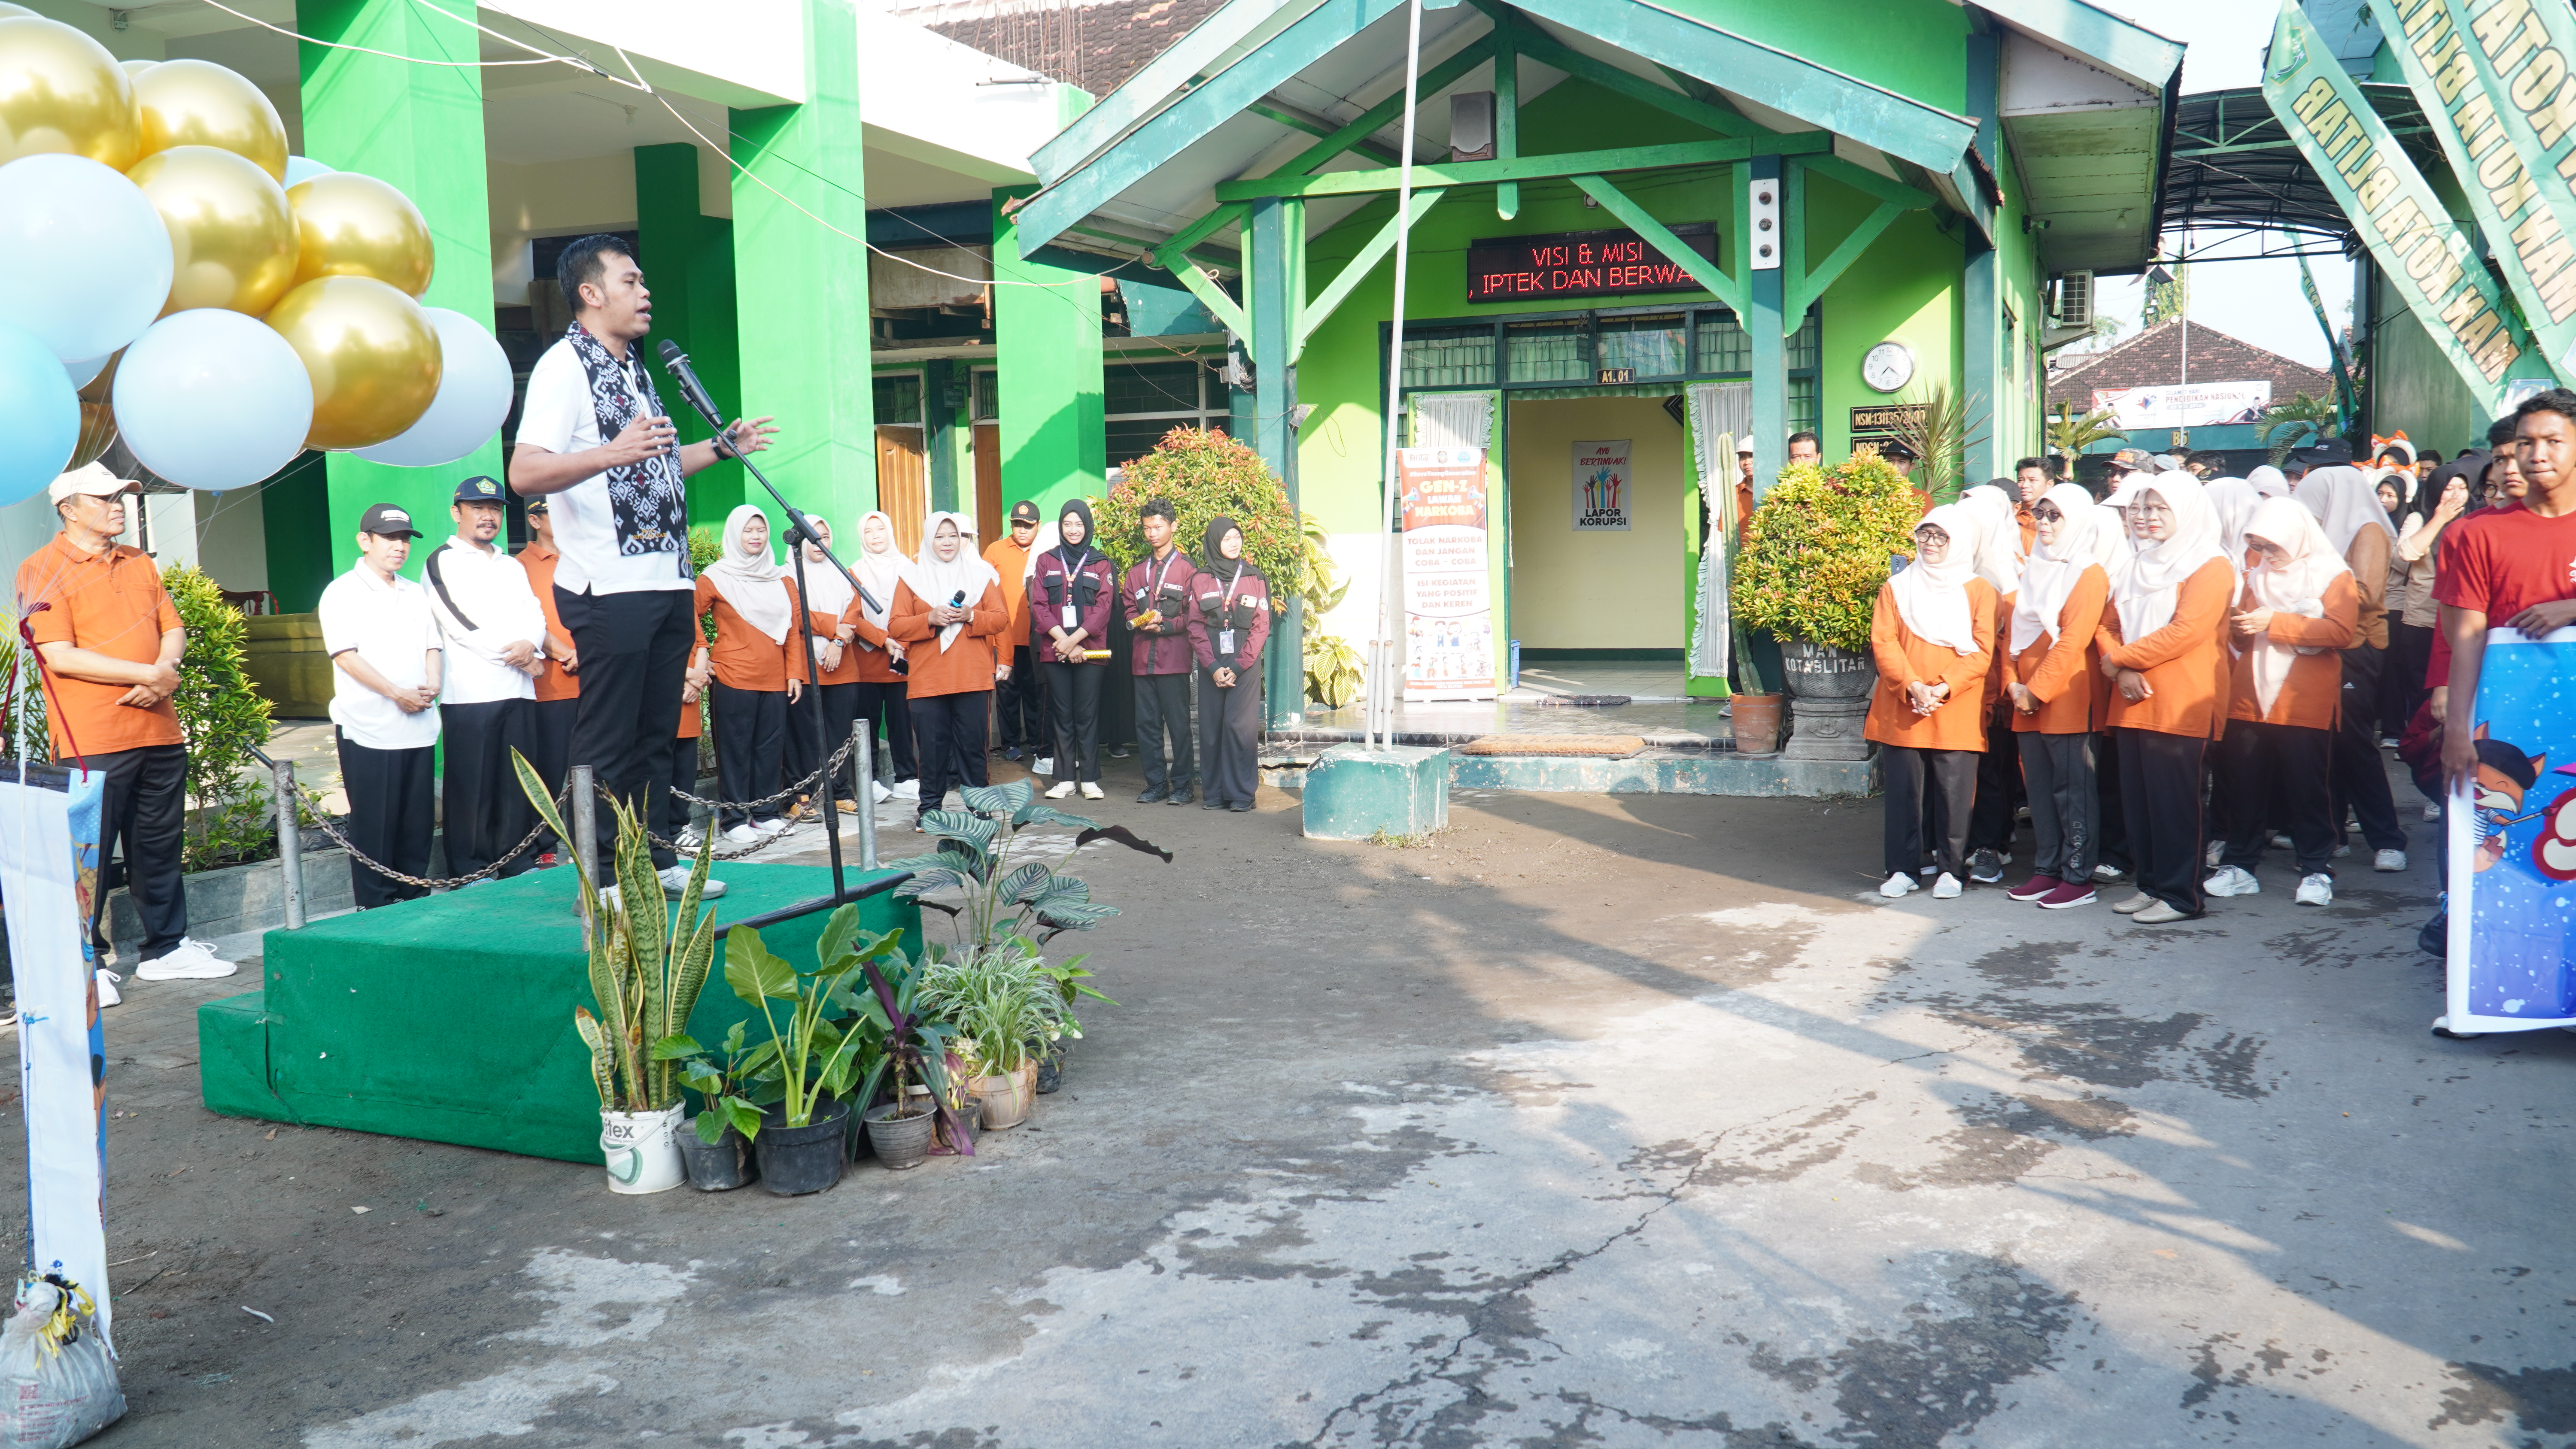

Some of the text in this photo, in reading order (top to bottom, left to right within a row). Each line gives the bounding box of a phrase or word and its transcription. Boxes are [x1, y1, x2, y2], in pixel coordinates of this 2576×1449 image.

[1532, 242, 1643, 267] VISI & MISI
[1482, 271, 1544, 294] IPTEK
[1552, 268, 1601, 290] DAN
[2211, 392, 2245, 400] NASIONL
[1596, 447, 1610, 455] AYO
[1580, 457, 1627, 466] BERTINDAK!
[1419, 480, 1468, 493] GEN-Z
[1427, 495, 1462, 504] LAWAN
[1415, 505, 1475, 517] NARKOBA
[1586, 508, 1621, 517] LAPOR
[1580, 517, 1626, 526] KORUPSI
[1803, 644, 1837, 658] MAN
